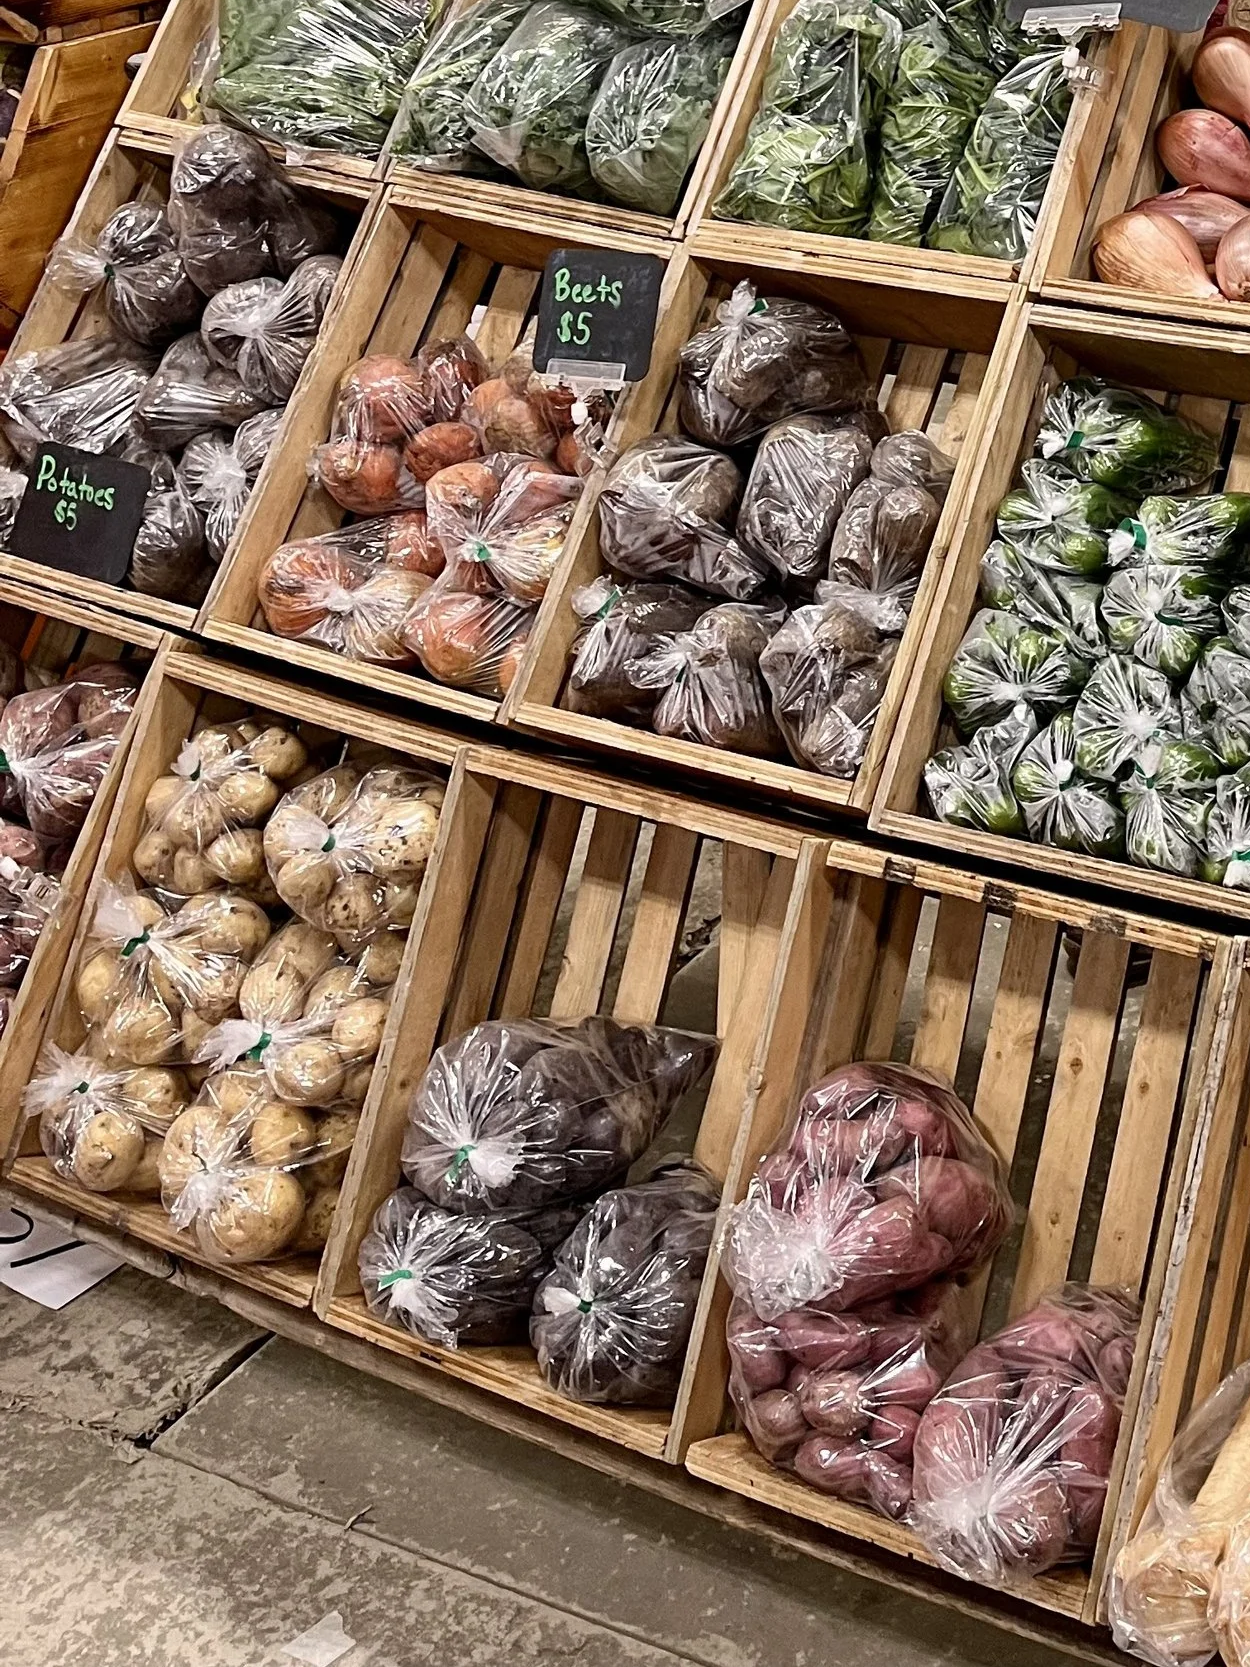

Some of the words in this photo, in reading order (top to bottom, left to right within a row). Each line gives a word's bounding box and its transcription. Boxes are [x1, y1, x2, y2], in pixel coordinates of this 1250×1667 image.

[554, 267, 623, 308] Beets
[557, 310, 593, 345] $5
[36, 455, 115, 510] Potatoes
[54, 499, 77, 531] $5
